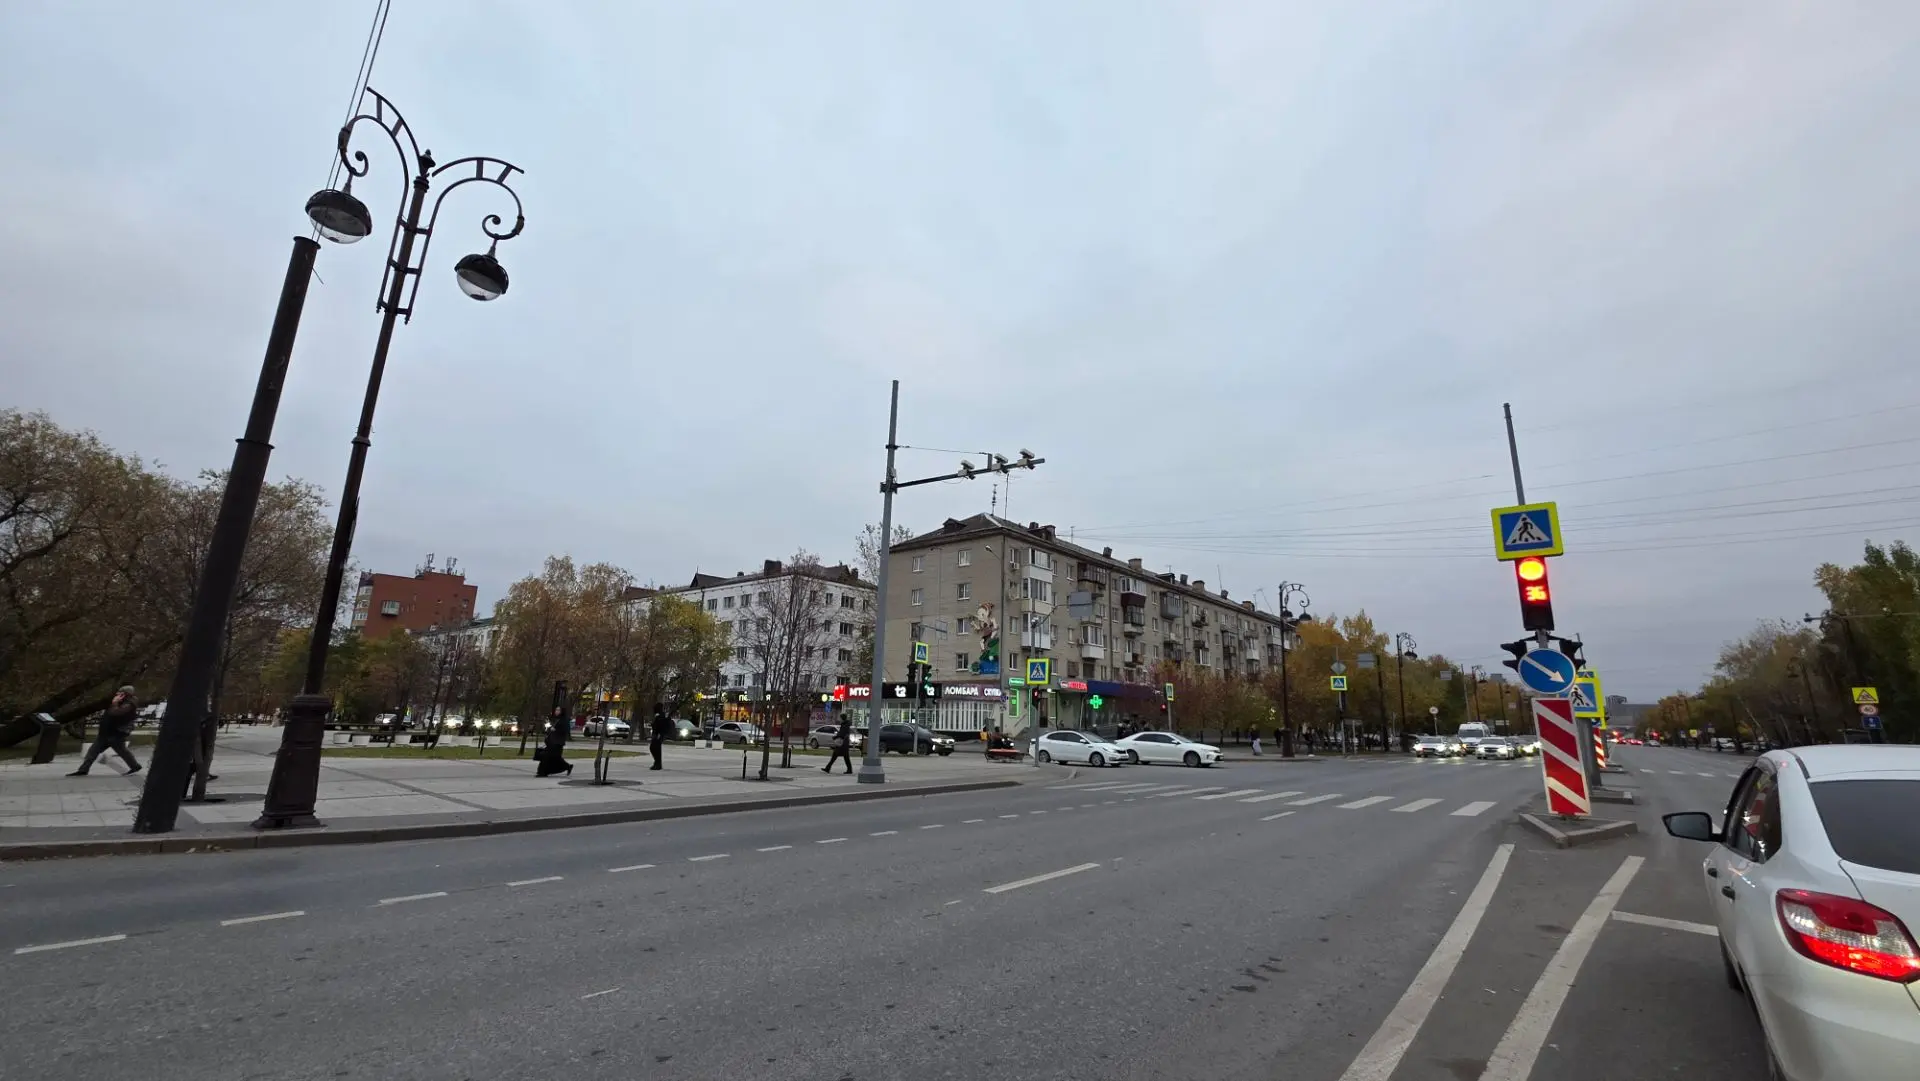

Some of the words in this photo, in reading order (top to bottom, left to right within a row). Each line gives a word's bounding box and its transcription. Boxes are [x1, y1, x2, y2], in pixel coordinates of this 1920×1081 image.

[1526, 586, 1547, 601] 36
[849, 687, 870, 697] МТС
[895, 685, 907, 698] t2
